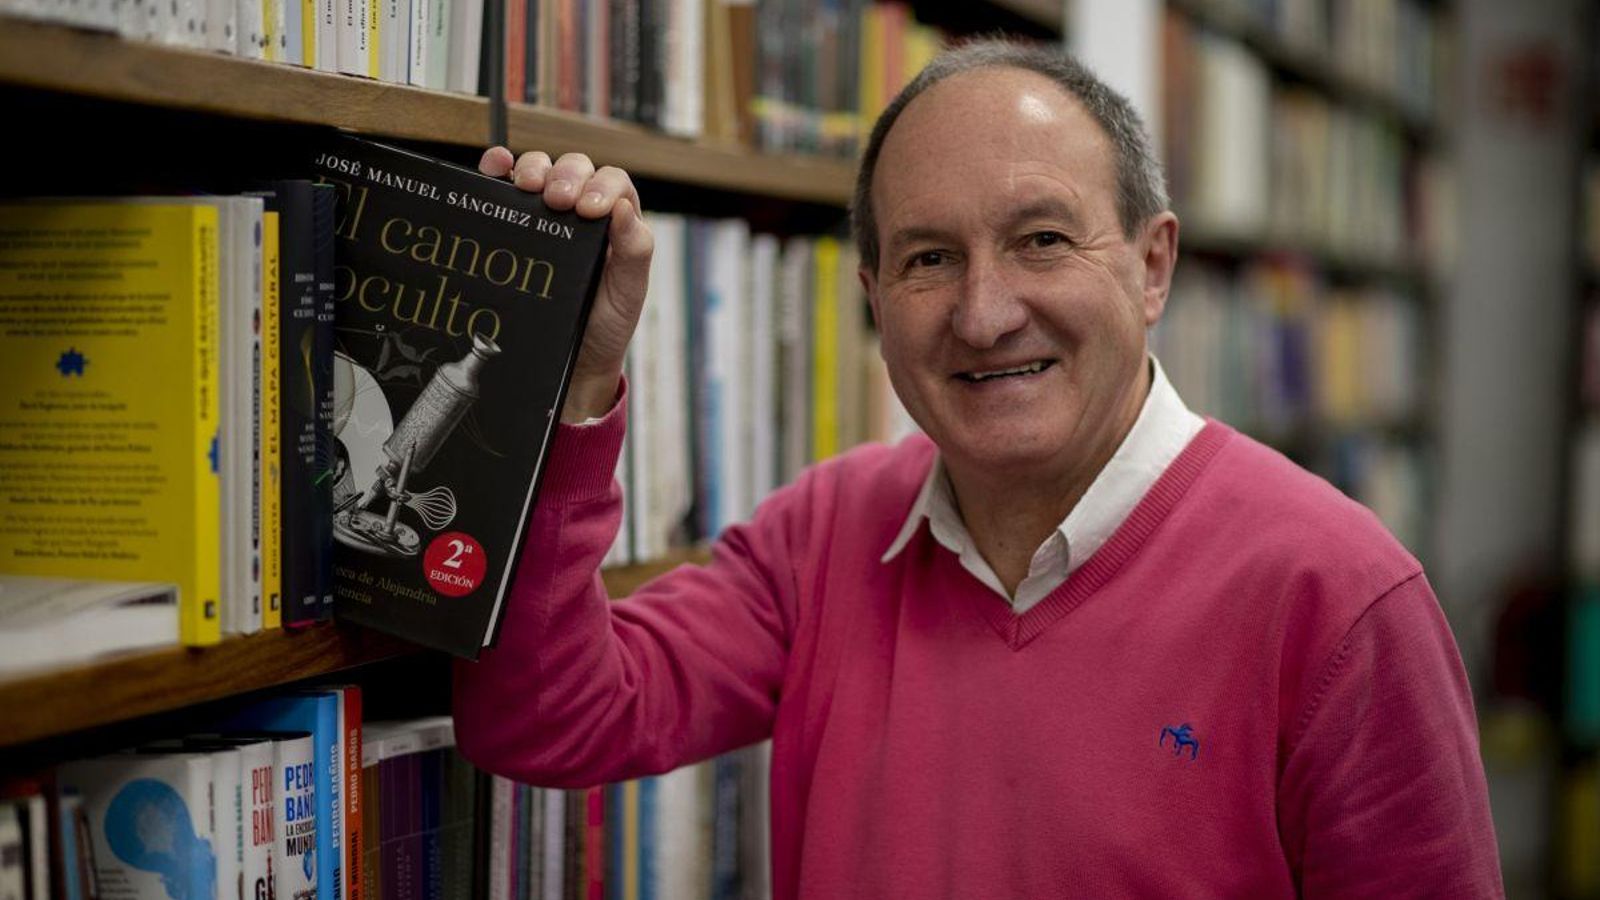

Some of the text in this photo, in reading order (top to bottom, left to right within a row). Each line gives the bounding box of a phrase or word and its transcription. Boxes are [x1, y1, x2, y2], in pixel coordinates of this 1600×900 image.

[315, 153, 575, 240] JOSÉ MANUEL SÁNCHEZ RON
[334, 255, 501, 342] oculto
[380, 217, 556, 300] canon
[269, 256, 277, 359] CULTURAL
[269, 367, 277, 426] MAPA
[430, 569, 475, 589] EDICIÓN
[350, 774, 358, 814] PEDRO
